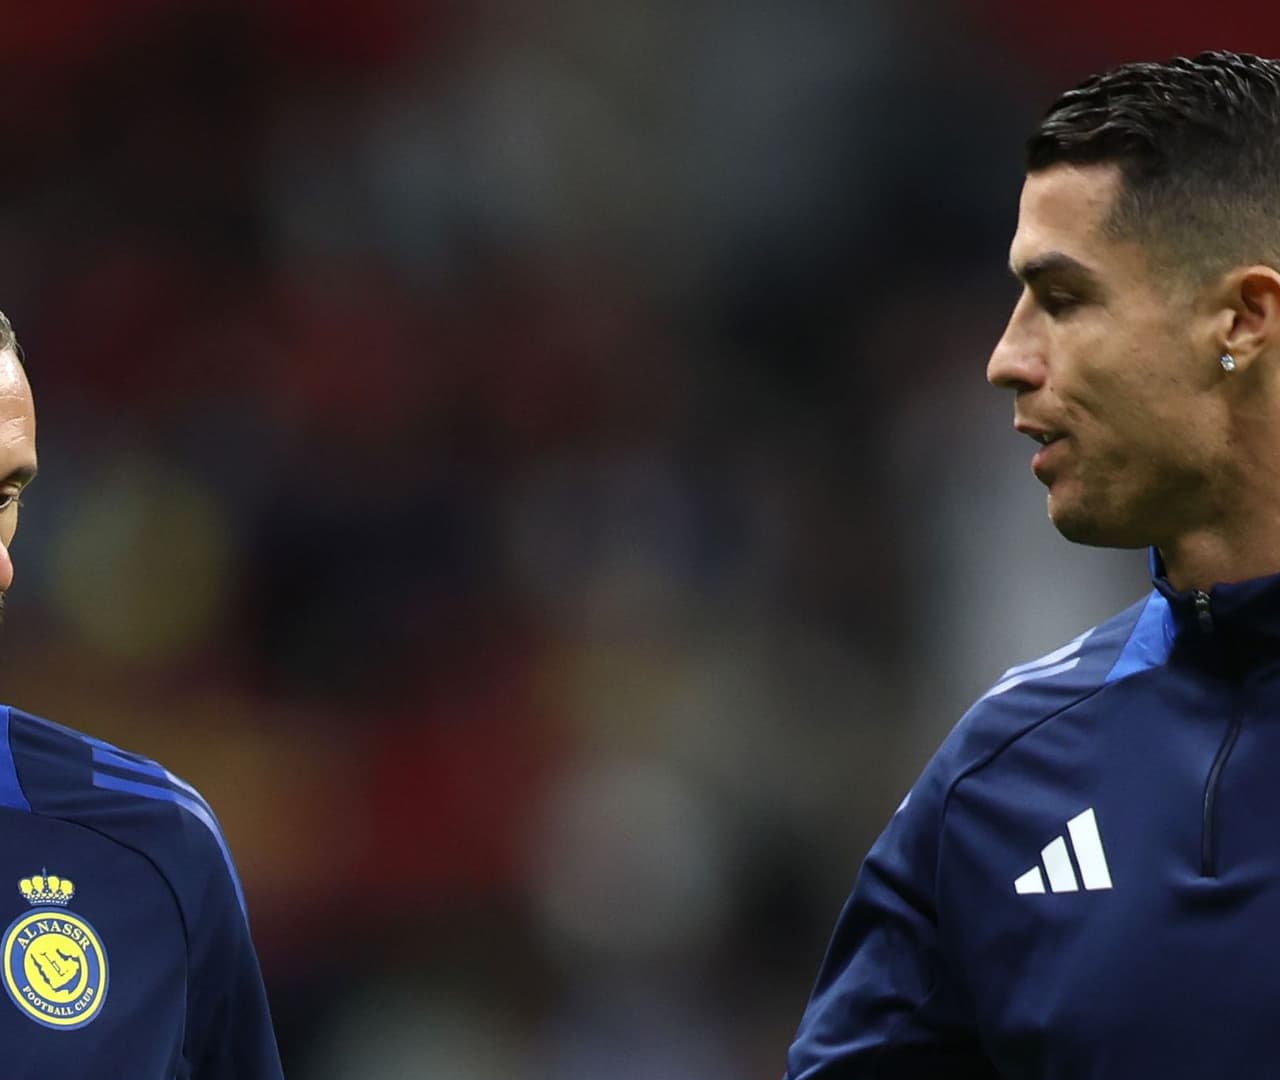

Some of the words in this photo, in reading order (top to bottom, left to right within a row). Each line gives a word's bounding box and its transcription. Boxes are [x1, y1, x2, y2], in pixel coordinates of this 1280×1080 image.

[37, 920, 91, 950] NASSR
[22, 985, 74, 1016] FOOTBALL
[75, 987, 94, 1012] CLUB
